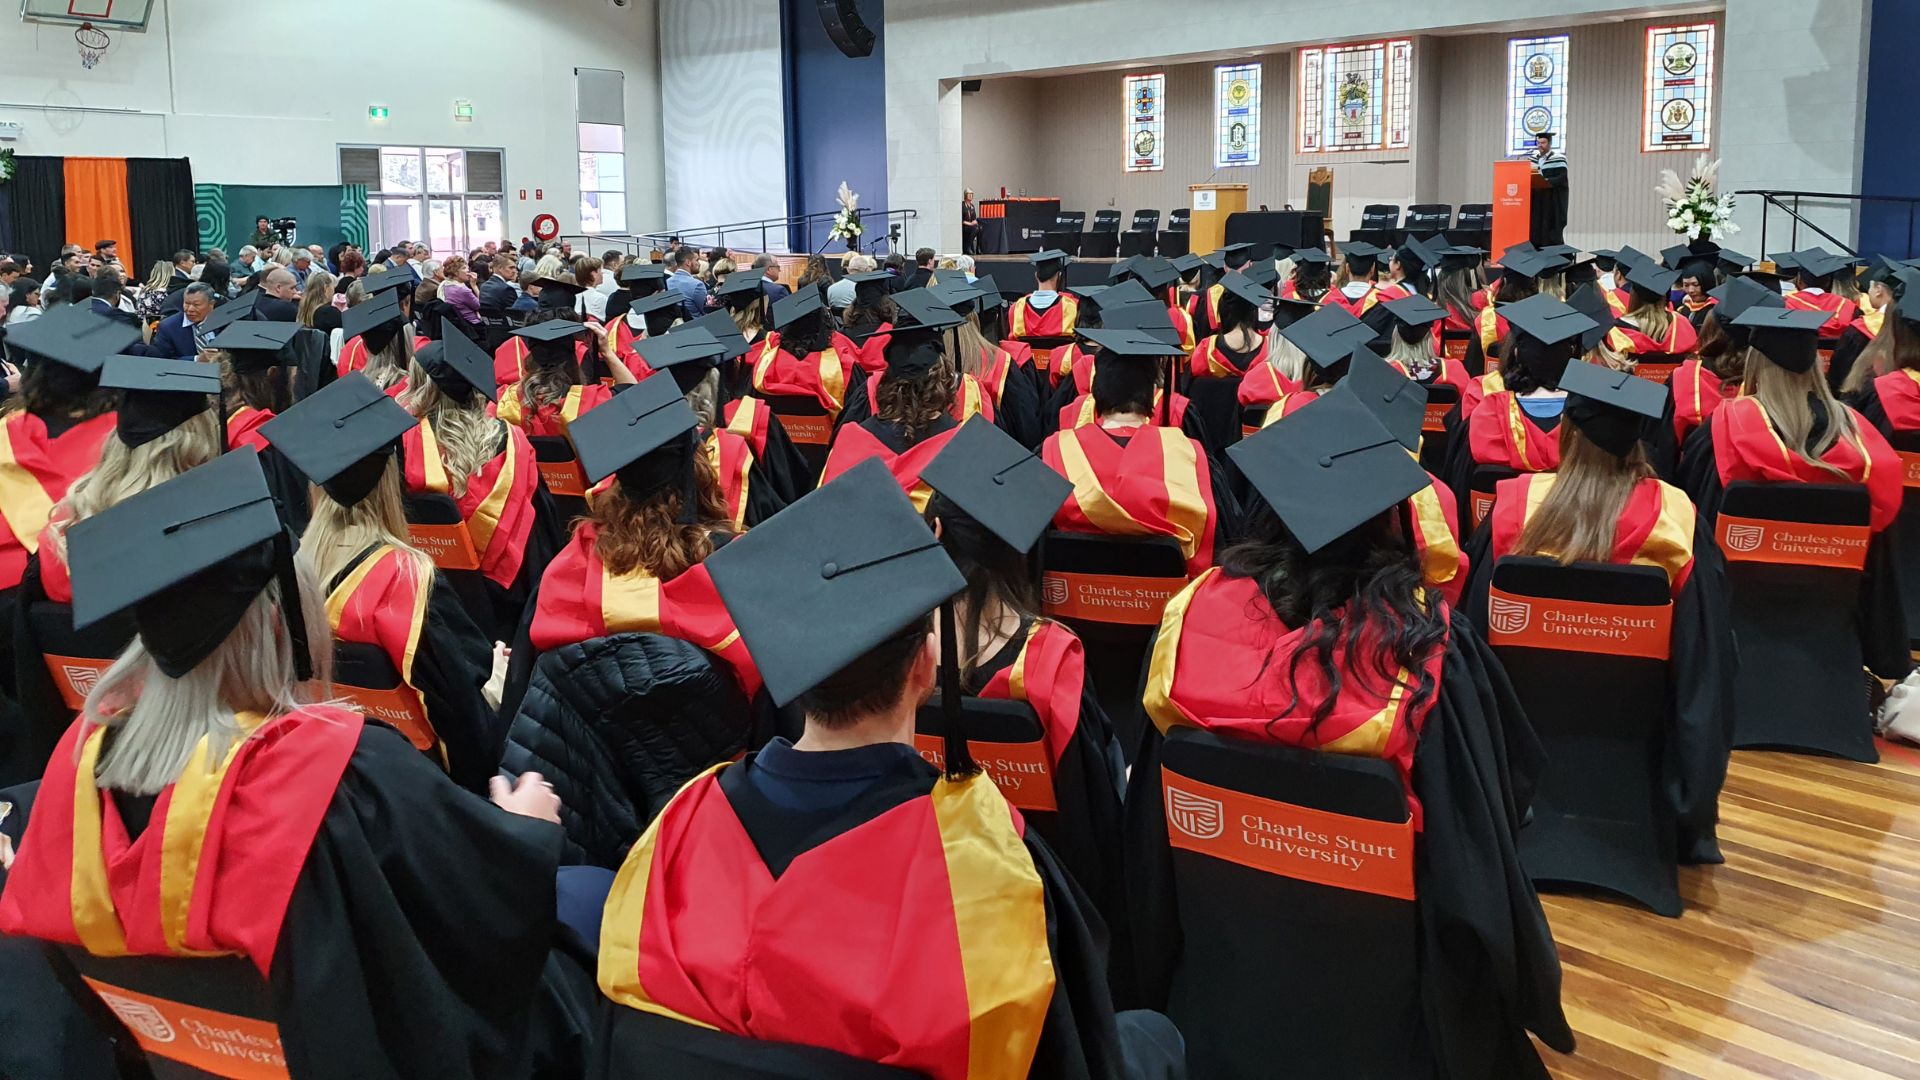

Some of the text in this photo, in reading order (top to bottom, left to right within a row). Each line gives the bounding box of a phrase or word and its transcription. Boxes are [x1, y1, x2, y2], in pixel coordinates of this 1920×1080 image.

[429, 536, 457, 546] Sturt
[1774, 531, 1867, 547] Charles Sturt
[1772, 541, 1846, 557] University
[1079, 584, 1171, 599] Charles Sturt
[1080, 594, 1153, 611] University
[1543, 610, 1656, 628] Charles Sturt
[1542, 622, 1632, 641] University
[375, 705, 414, 720] Sturt
[995, 758, 1046, 774] Sturt
[1241, 814, 1397, 859] Charles Sturt
[1242, 830, 1364, 872] University
[180, 1017, 274, 1049] Charles
[191, 1033, 287, 1068] Univers
